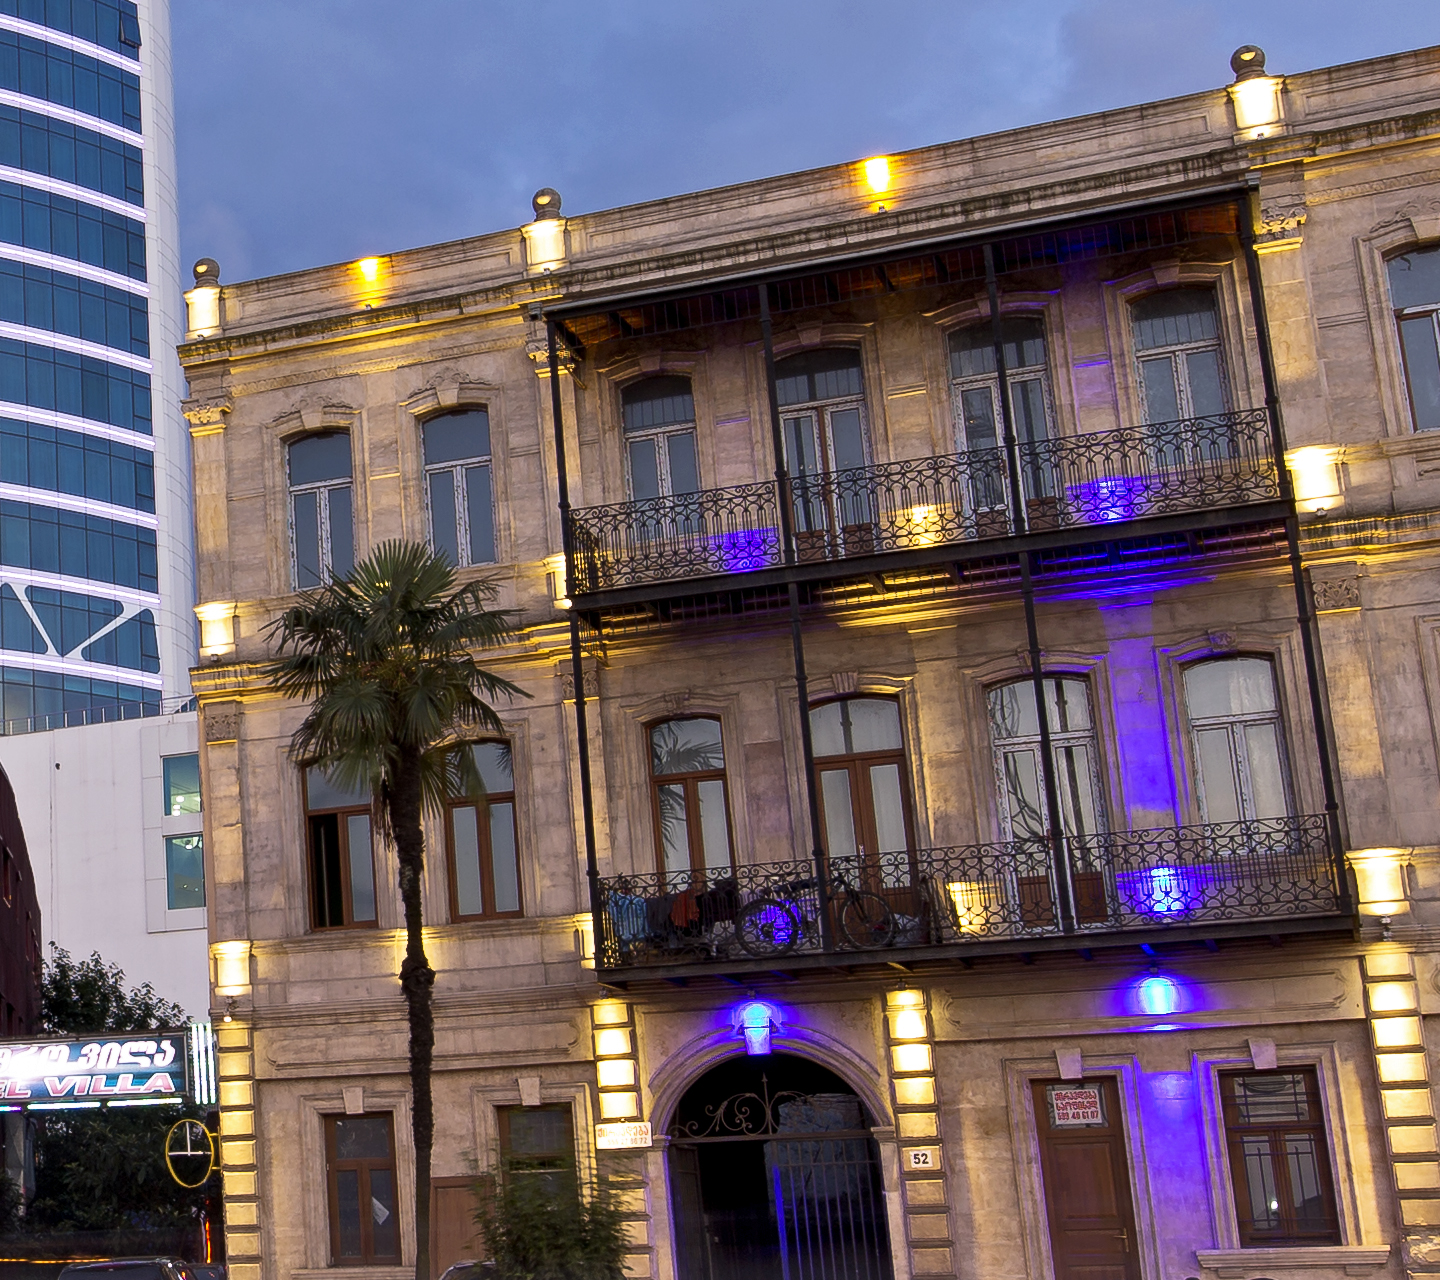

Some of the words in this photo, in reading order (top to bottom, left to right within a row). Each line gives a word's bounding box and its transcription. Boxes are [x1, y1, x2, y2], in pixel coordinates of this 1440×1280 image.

[79, 1040, 176, 1070] ვილა
[43, 1072, 176, 1097] VILLA
[913, 1153, 929, 1165] 52
